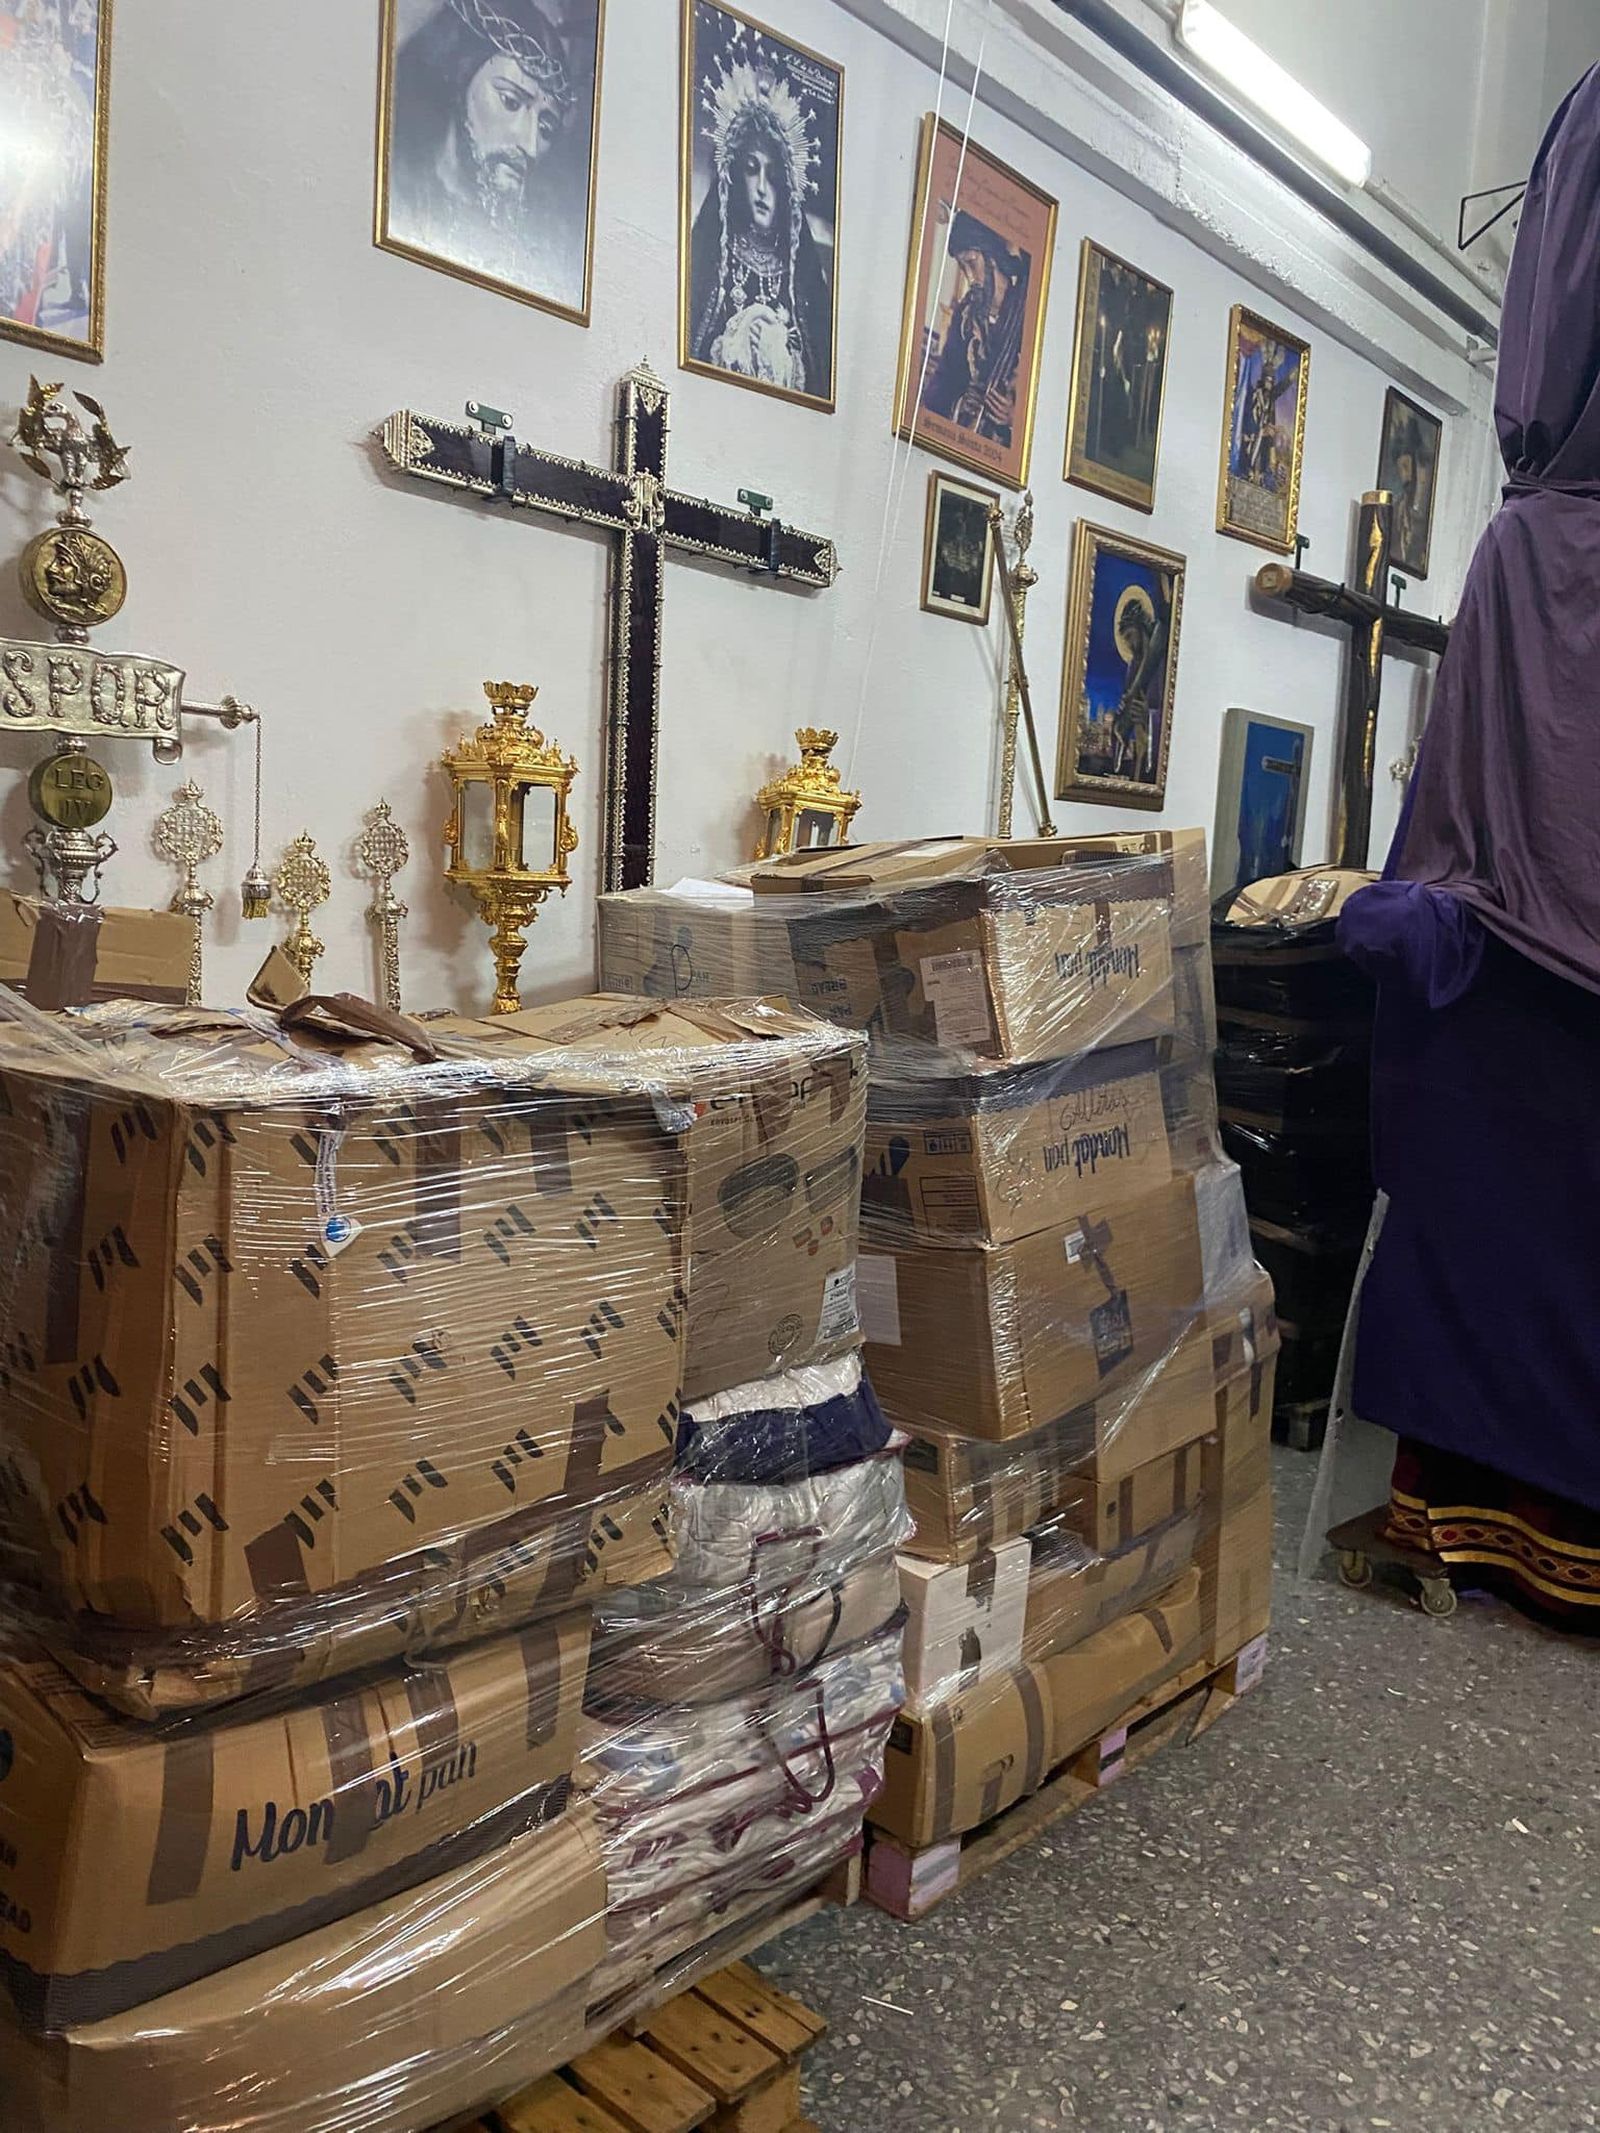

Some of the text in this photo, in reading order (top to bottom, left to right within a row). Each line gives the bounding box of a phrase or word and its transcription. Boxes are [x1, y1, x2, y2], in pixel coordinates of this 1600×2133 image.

[3, 651, 174, 730] SPQR
[55, 767, 104, 791] LEG
[1043, 1122, 1131, 1179] Mondat pan
[231, 1741, 477, 1872] Monat pan
